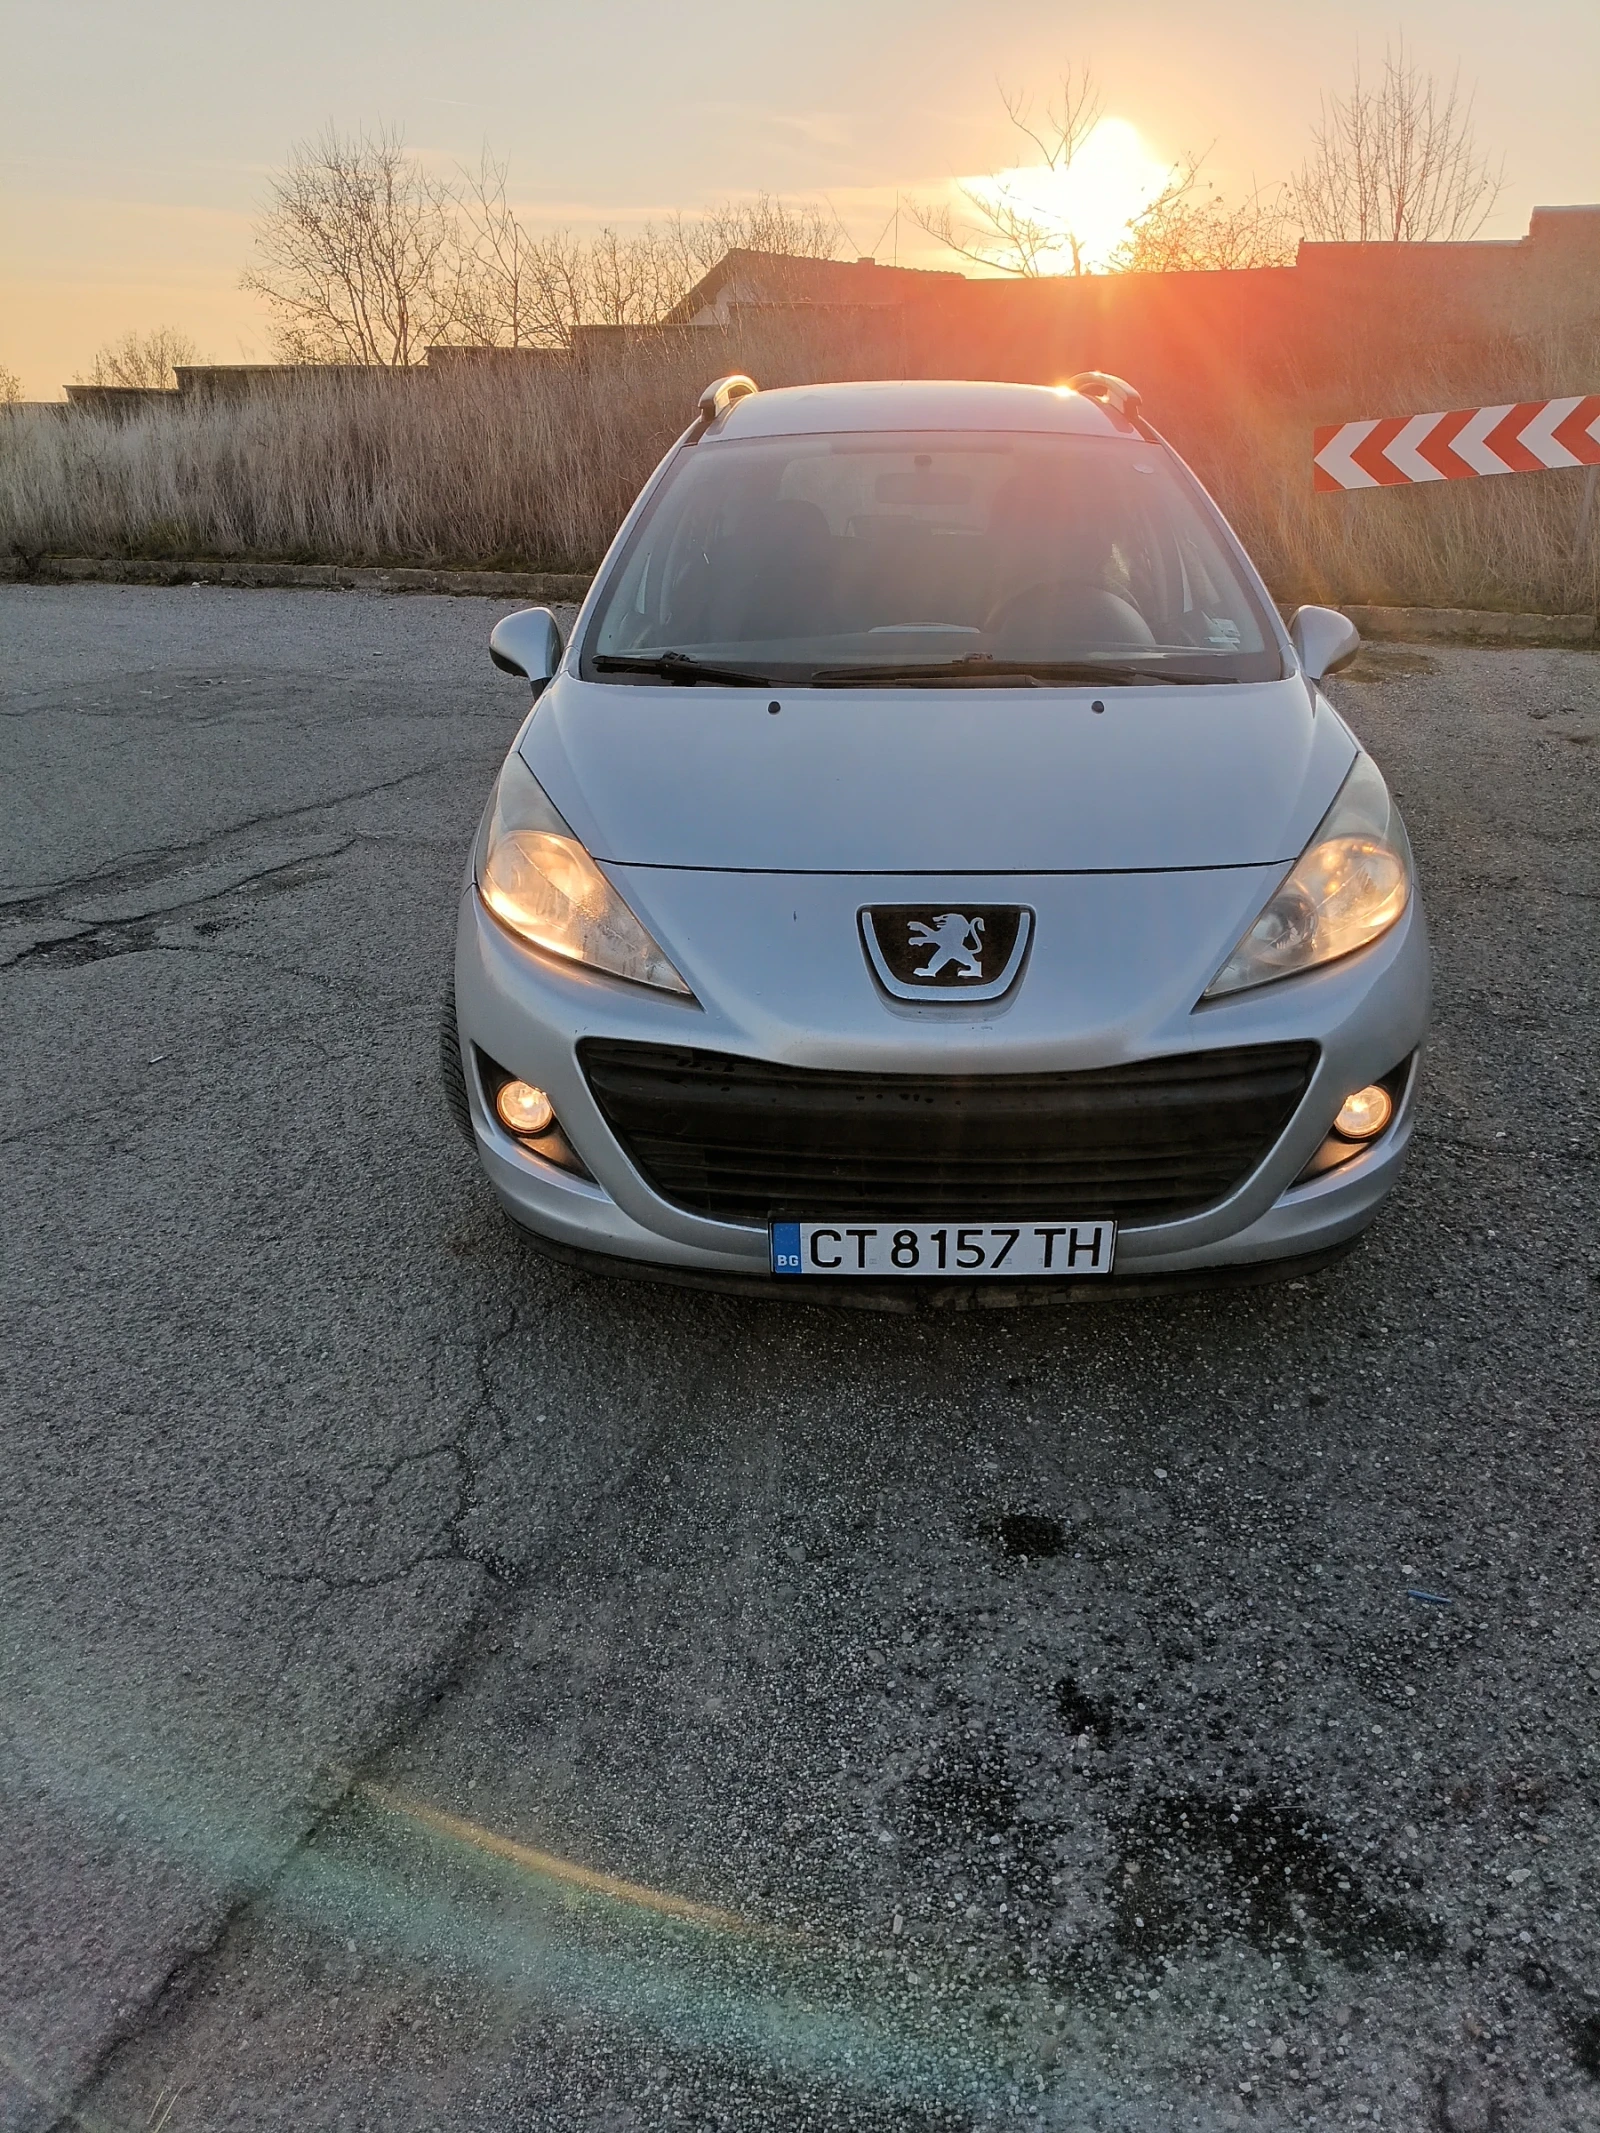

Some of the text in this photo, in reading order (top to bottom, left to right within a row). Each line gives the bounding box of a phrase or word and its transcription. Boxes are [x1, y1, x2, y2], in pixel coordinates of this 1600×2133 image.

[777, 1254, 799, 1267] BG
[809, 1227, 1103, 1269] CT 8157 TH
